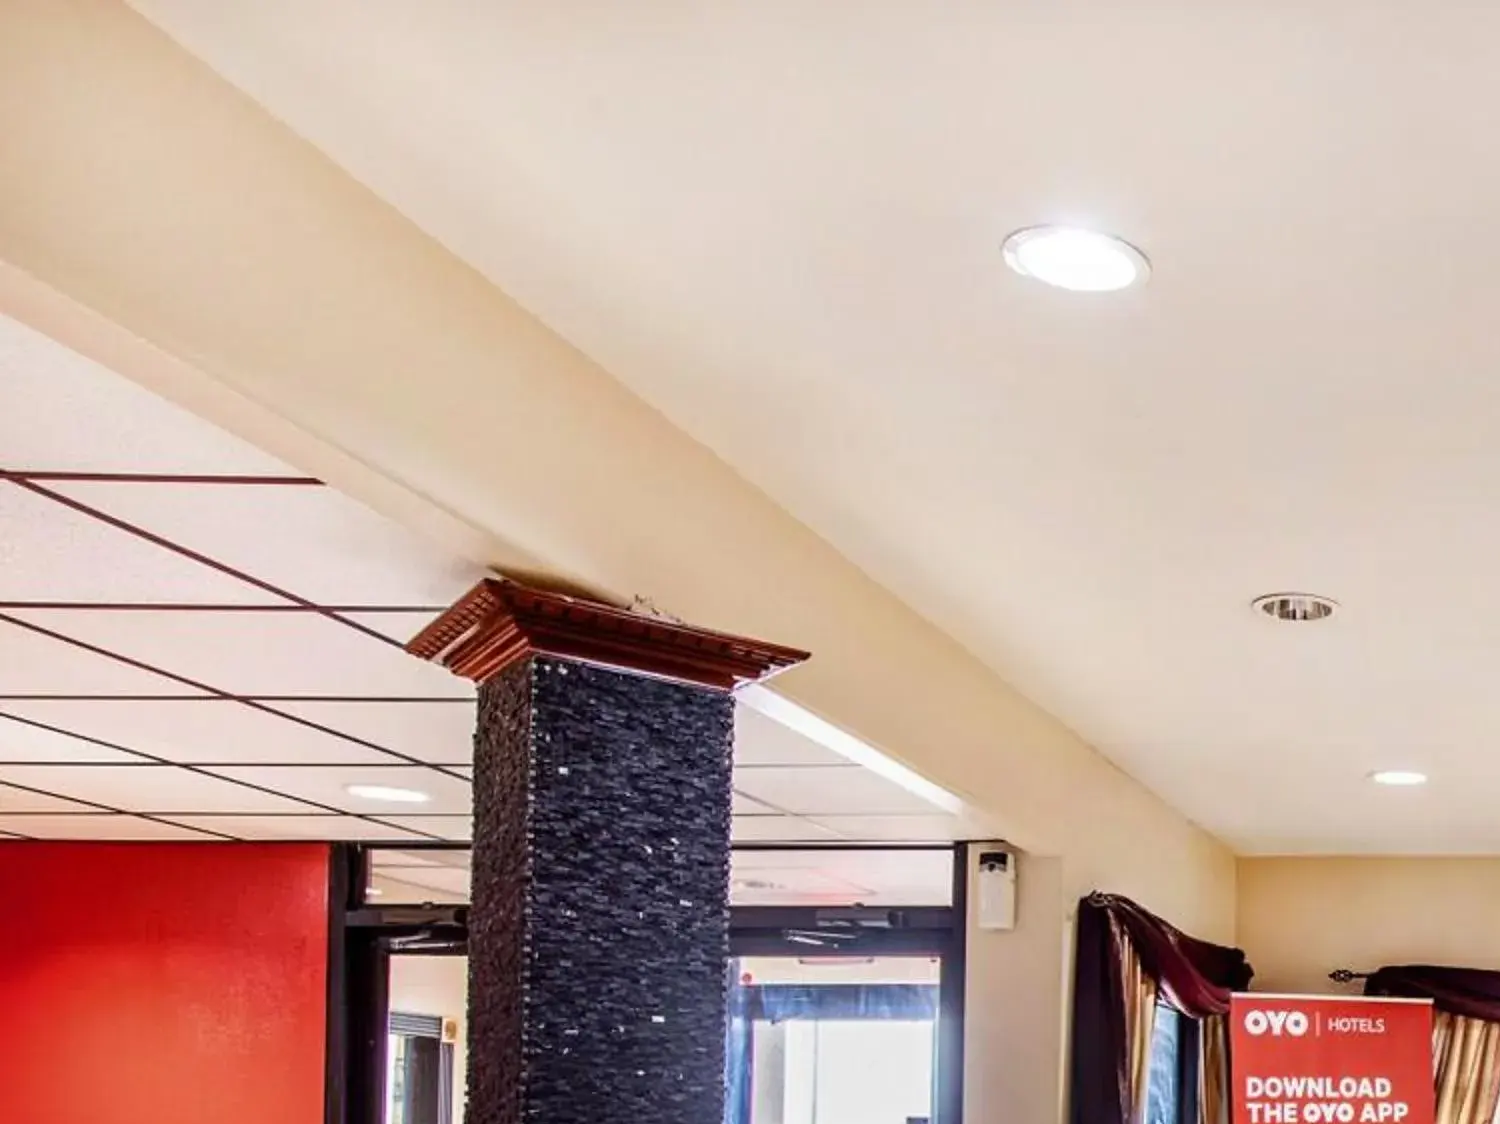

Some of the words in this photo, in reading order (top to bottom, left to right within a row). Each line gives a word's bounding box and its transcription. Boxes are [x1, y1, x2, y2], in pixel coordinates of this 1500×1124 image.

[1244, 1010, 1309, 1036] OYO
[1327, 1017, 1386, 1034] HOTELS
[1245, 1076, 1392, 1099] DOWNLOAD
[1246, 1103, 1298, 1124] THE
[1303, 1103, 1354, 1123] OYO
[1359, 1102, 1409, 1123] APP
